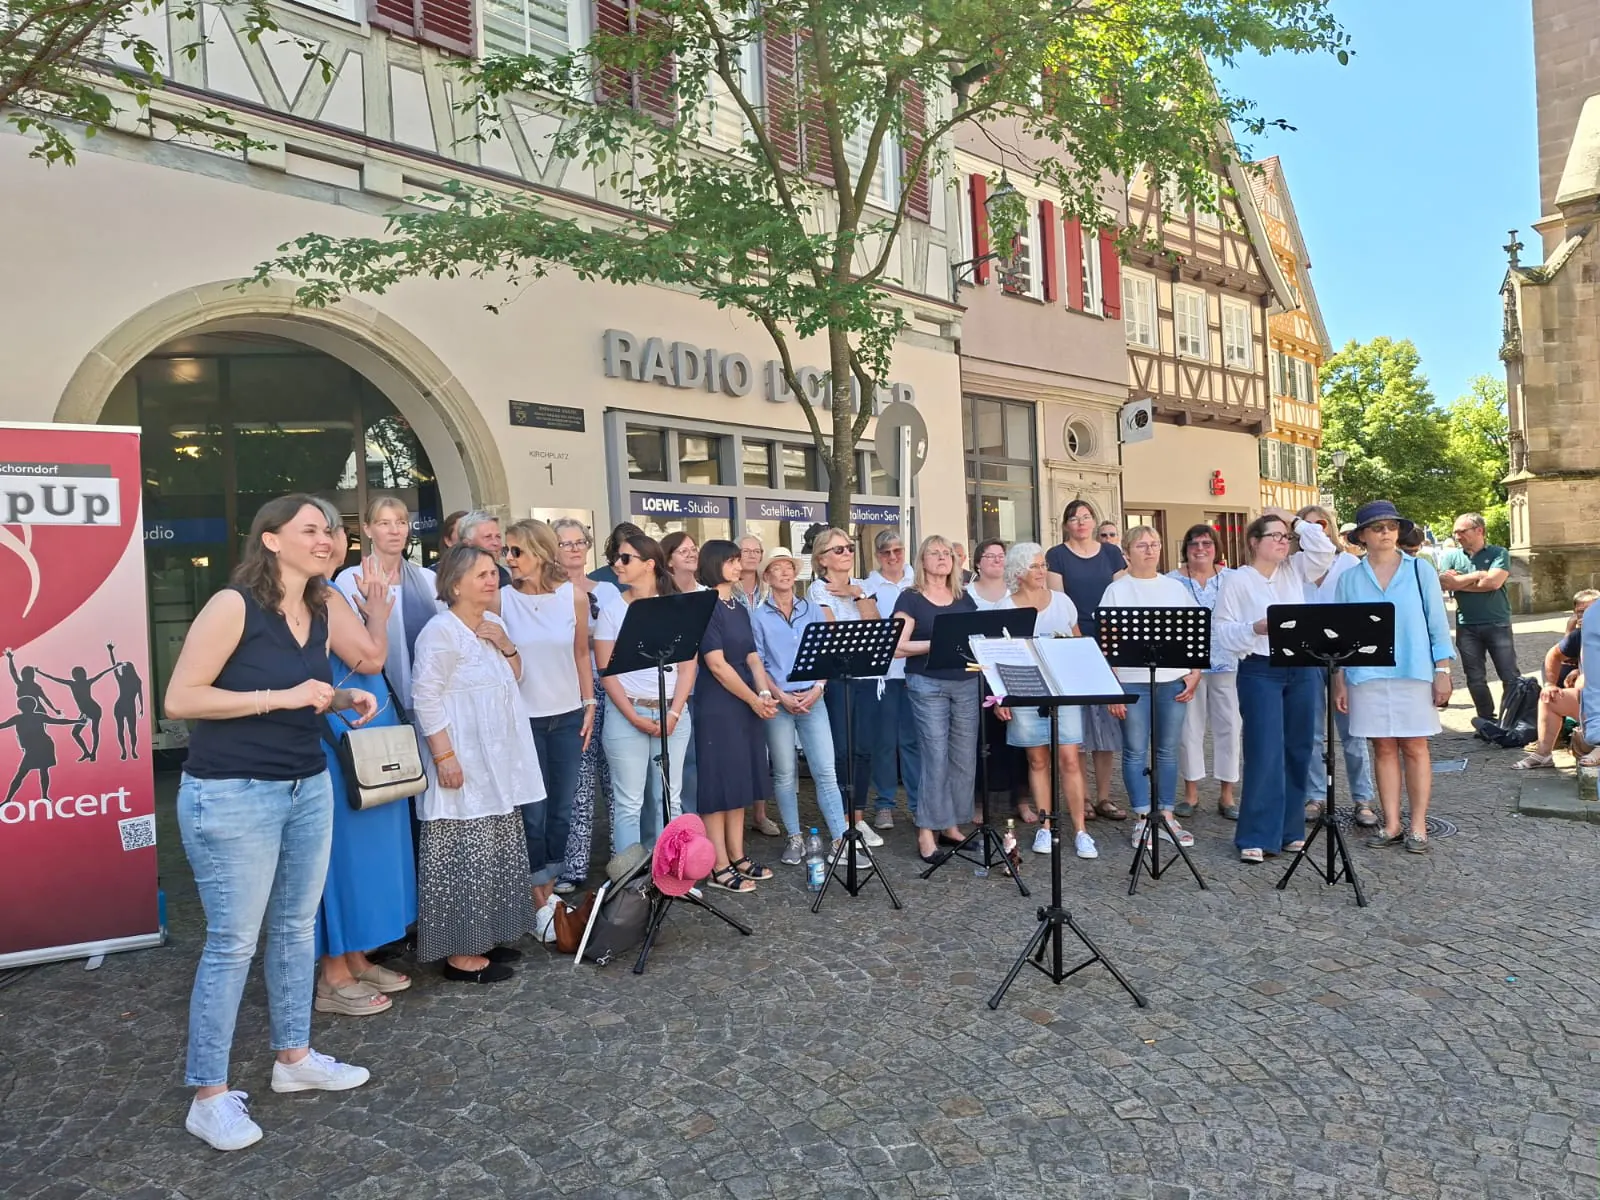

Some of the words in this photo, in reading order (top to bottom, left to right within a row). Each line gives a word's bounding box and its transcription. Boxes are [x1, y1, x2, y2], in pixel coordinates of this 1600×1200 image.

[602, 328, 753, 397] RADIO
[529, 450, 569, 460] KIRCHPLATZ
[0, 463, 59, 474] chorndorf
[544, 462, 553, 486] 1
[760, 504, 814, 519] Satelliten-TV
